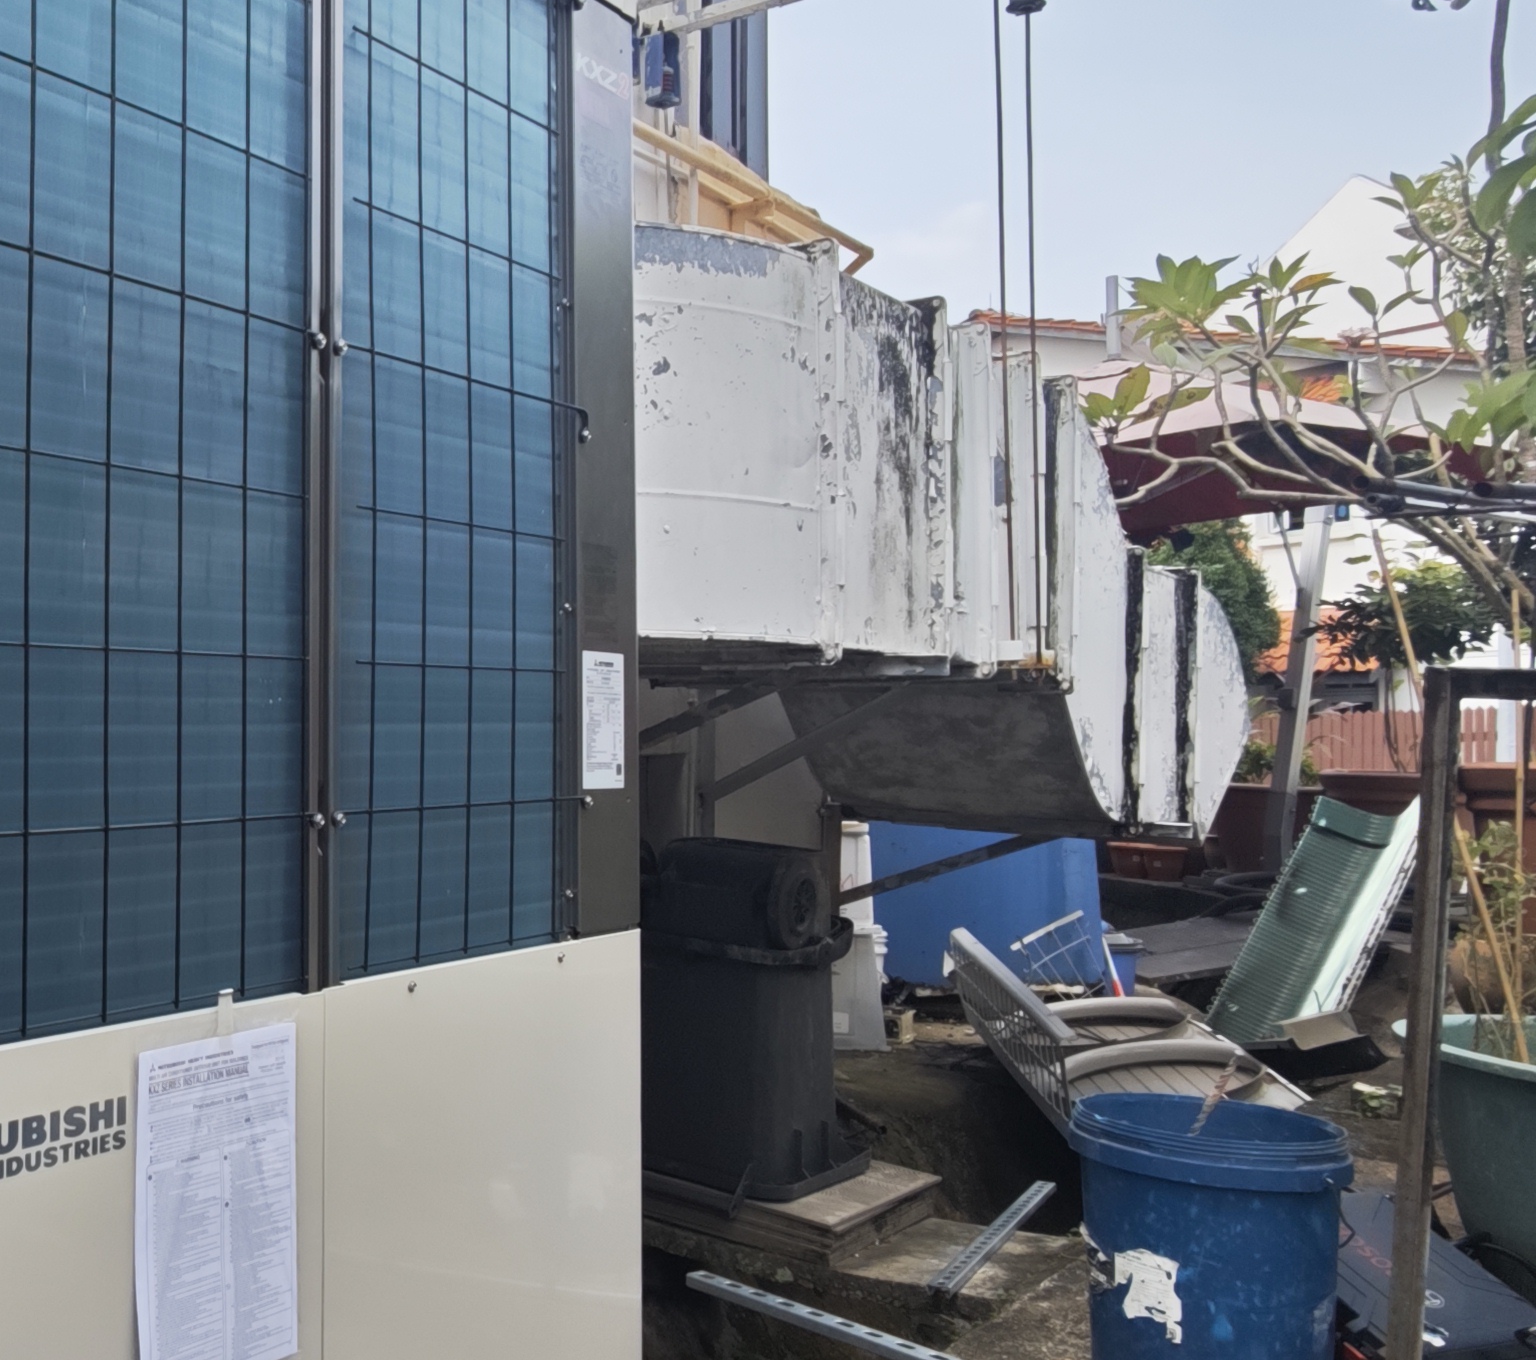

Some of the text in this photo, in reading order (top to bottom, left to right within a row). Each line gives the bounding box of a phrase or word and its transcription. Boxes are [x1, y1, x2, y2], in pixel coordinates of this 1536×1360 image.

[162, 1078, 182, 1092] SERIES
[183, 1069, 224, 1087] INSTALLATION
[225, 1063, 249, 1077] MANUAL
